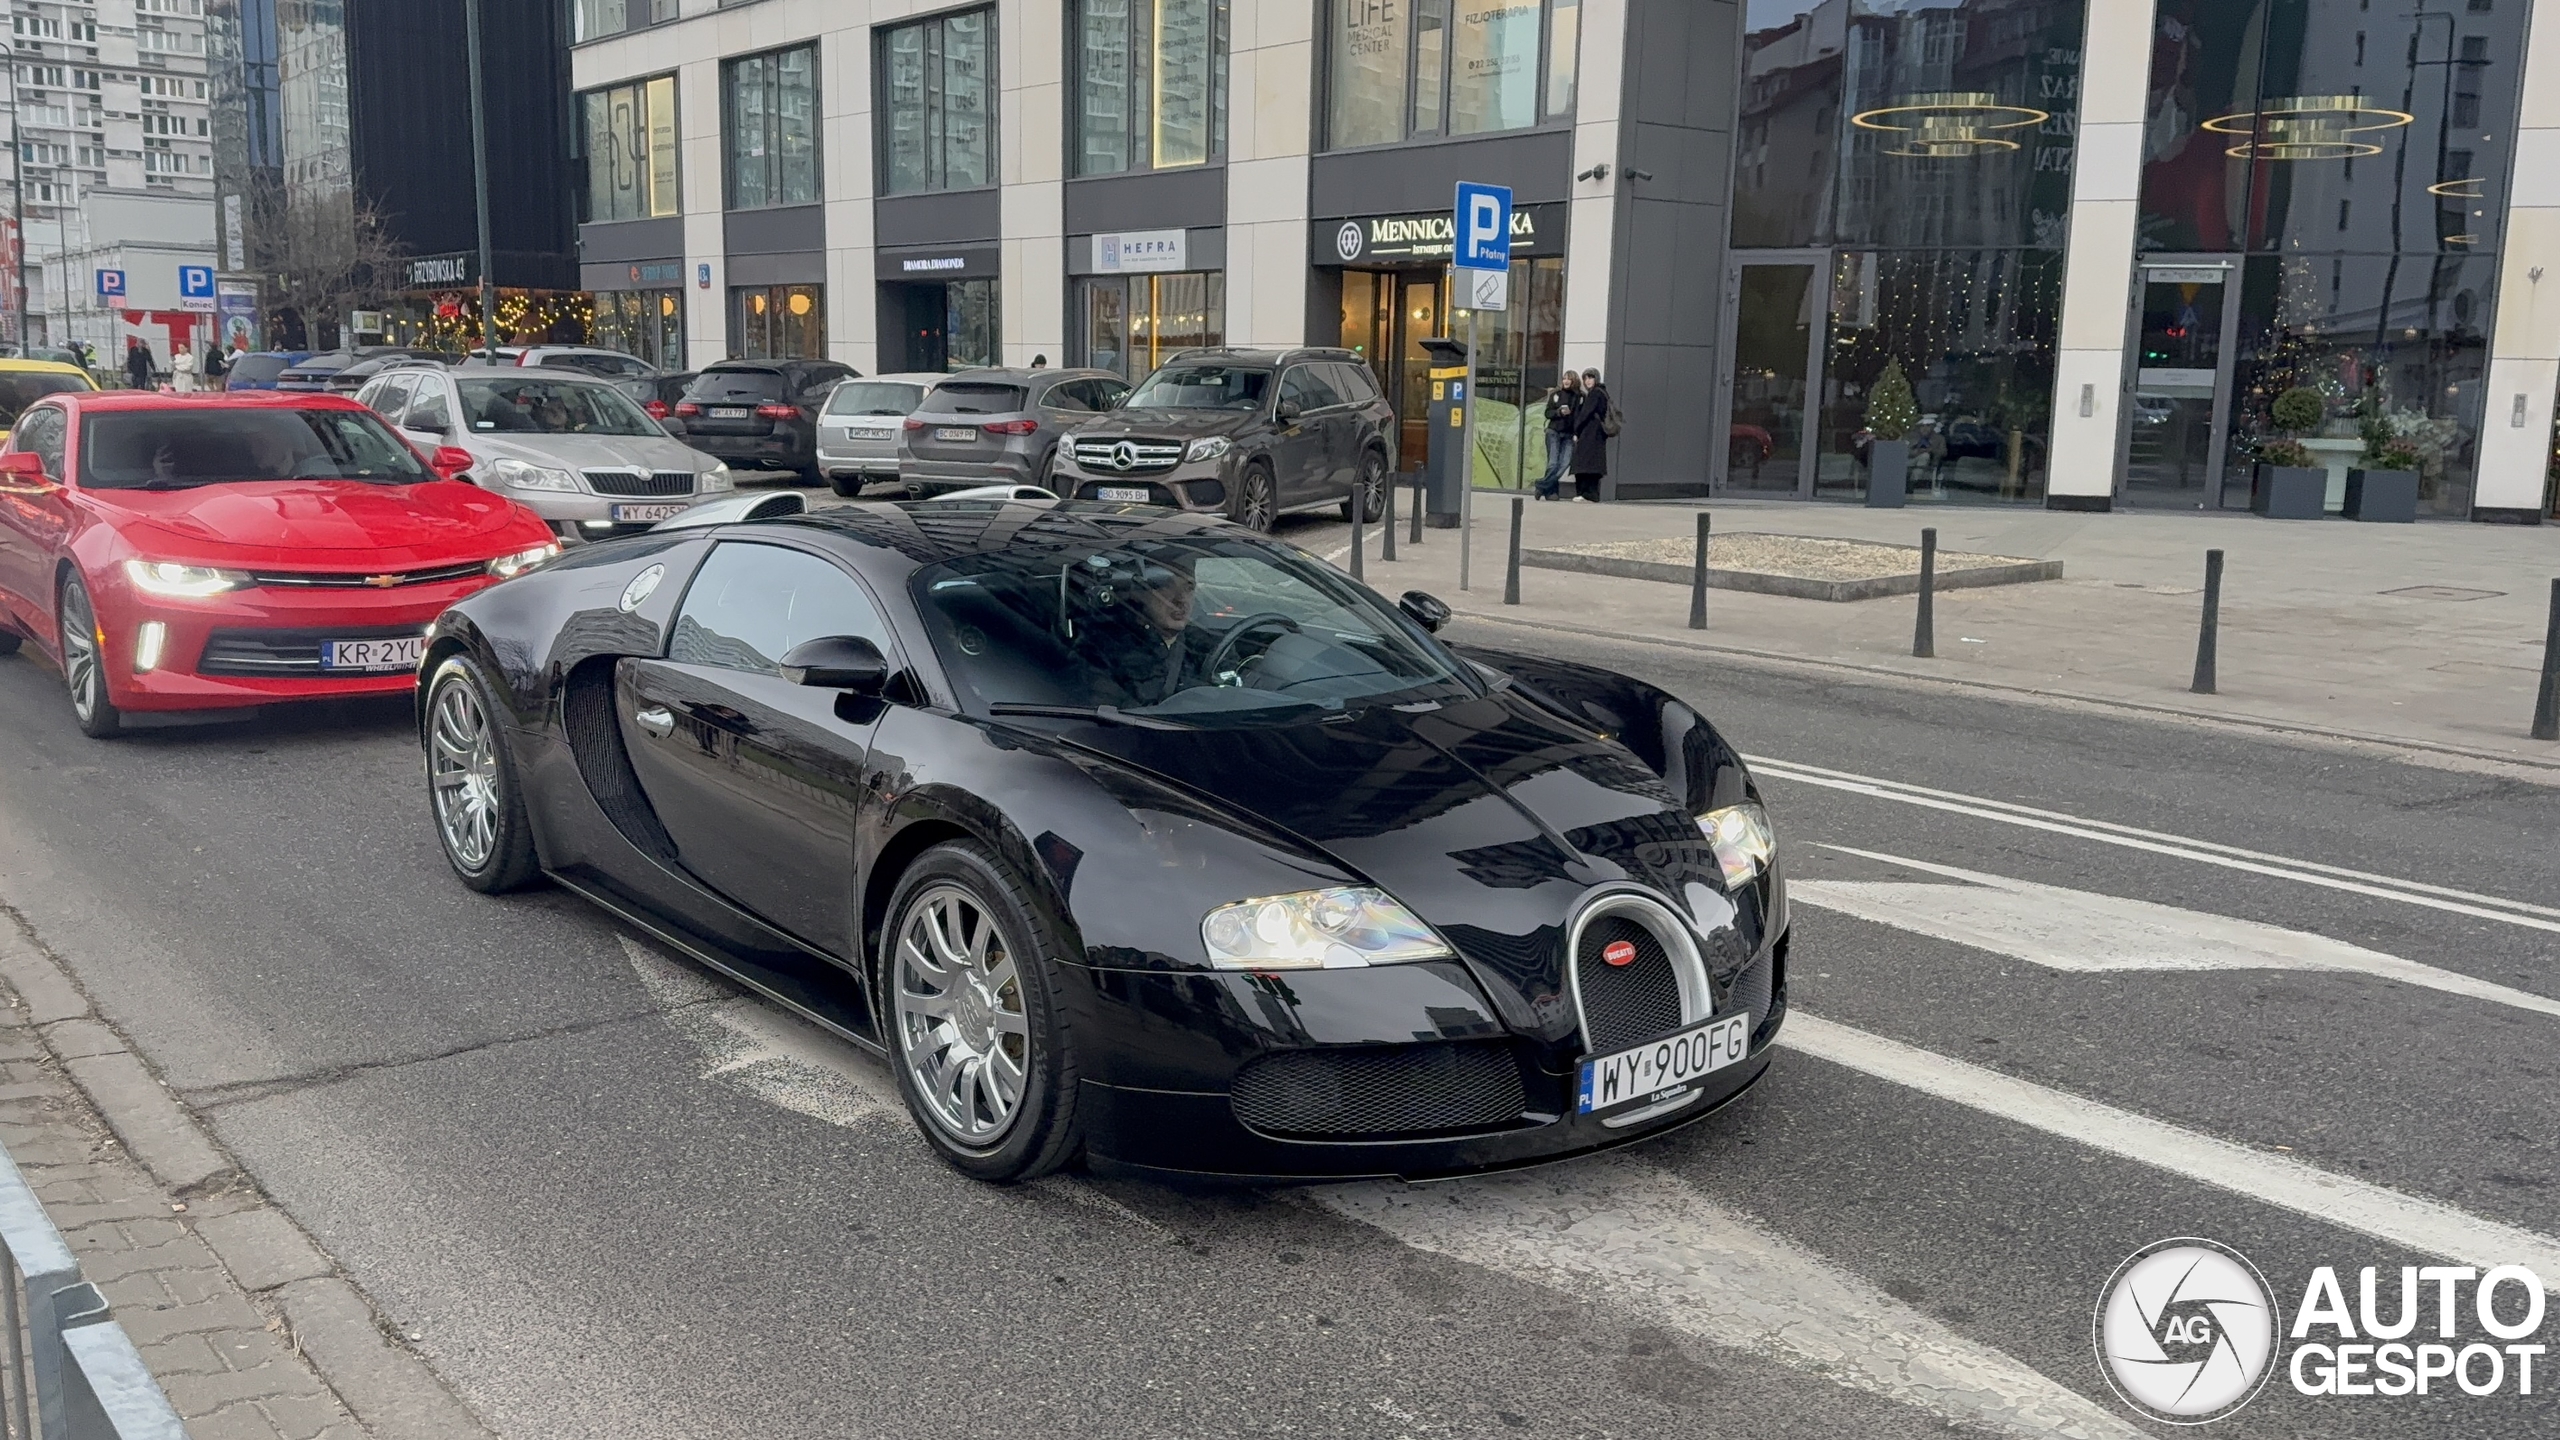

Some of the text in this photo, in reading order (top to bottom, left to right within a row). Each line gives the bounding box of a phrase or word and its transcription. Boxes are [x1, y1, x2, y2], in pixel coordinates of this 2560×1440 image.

[1348, 0, 1394, 28] LIFE
[1465, 5, 1529, 25] FIZJOTERAPIA
[1348, 25, 1393, 42] MEDICAL
[1350, 39, 1390, 56] CENTER
[1371, 217, 1454, 243] MENNICA
[1469, 193, 1501, 258] P
[1124, 240, 1176, 254] HEFRA
[1480, 246, 1506, 262] Płatny
[414, 257, 465, 284] GRZYBOWSKA 43
[931, 257, 965, 270] DIAMONDS
[102, 271, 121, 293] P
[187, 268, 207, 294] P
[183, 300, 213, 309] Koniec
[622, 507, 640, 519] WY
[338, 643, 370, 664] KR
[1606, 947, 1633, 961] BUGATTI
[1603, 1019, 1742, 1104] WY 900FG
[1579, 1094, 1591, 1107] PL
